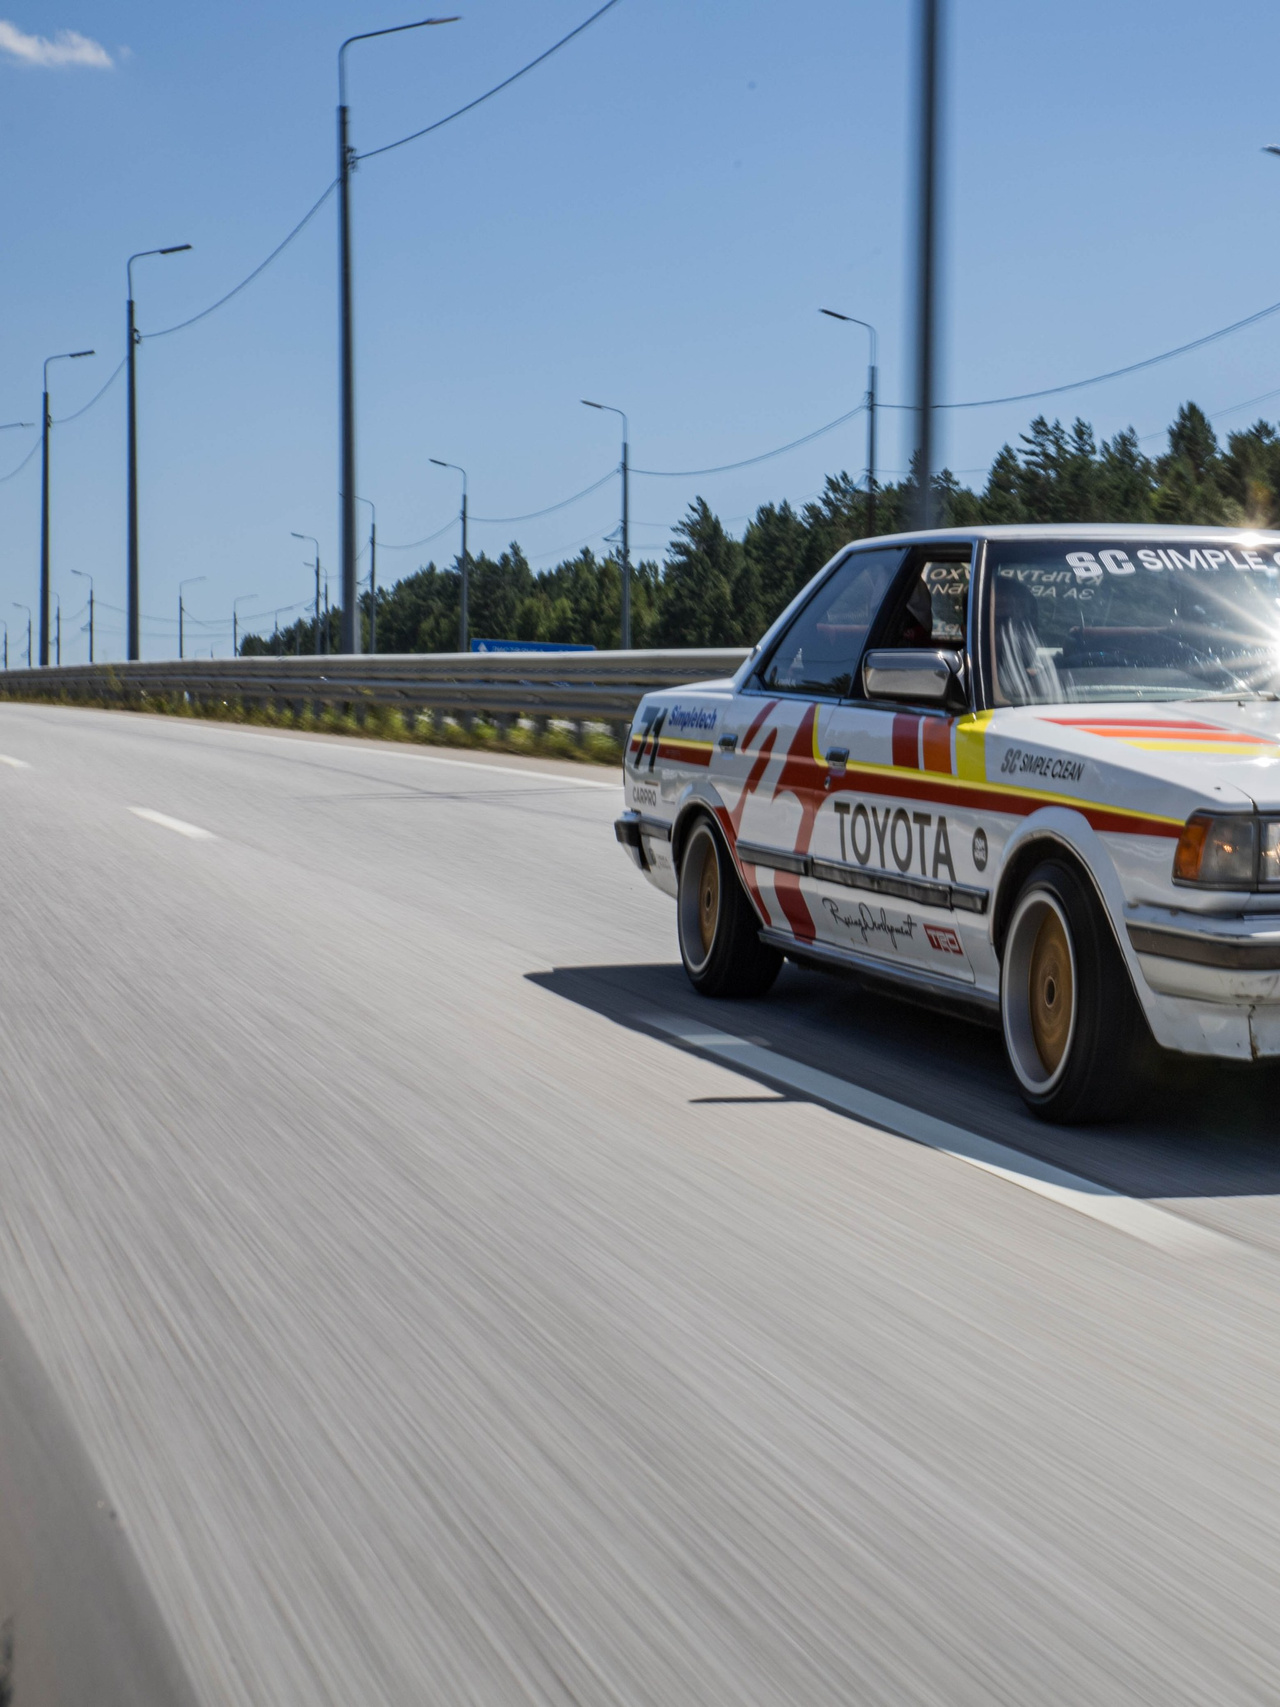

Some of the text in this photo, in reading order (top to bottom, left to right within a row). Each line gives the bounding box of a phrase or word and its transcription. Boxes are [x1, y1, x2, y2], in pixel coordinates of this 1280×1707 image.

[1065, 549, 1136, 577] SC
[1137, 549, 1267, 572] SIMPLE
[668, 705, 718, 731] Simpletech
[633, 705, 668, 773] 71
[1000, 748, 1085, 781] SC SIMPLE CLEAN
[632, 786, 657, 807] CARPRO
[834, 801, 957, 883] TOYOTA
